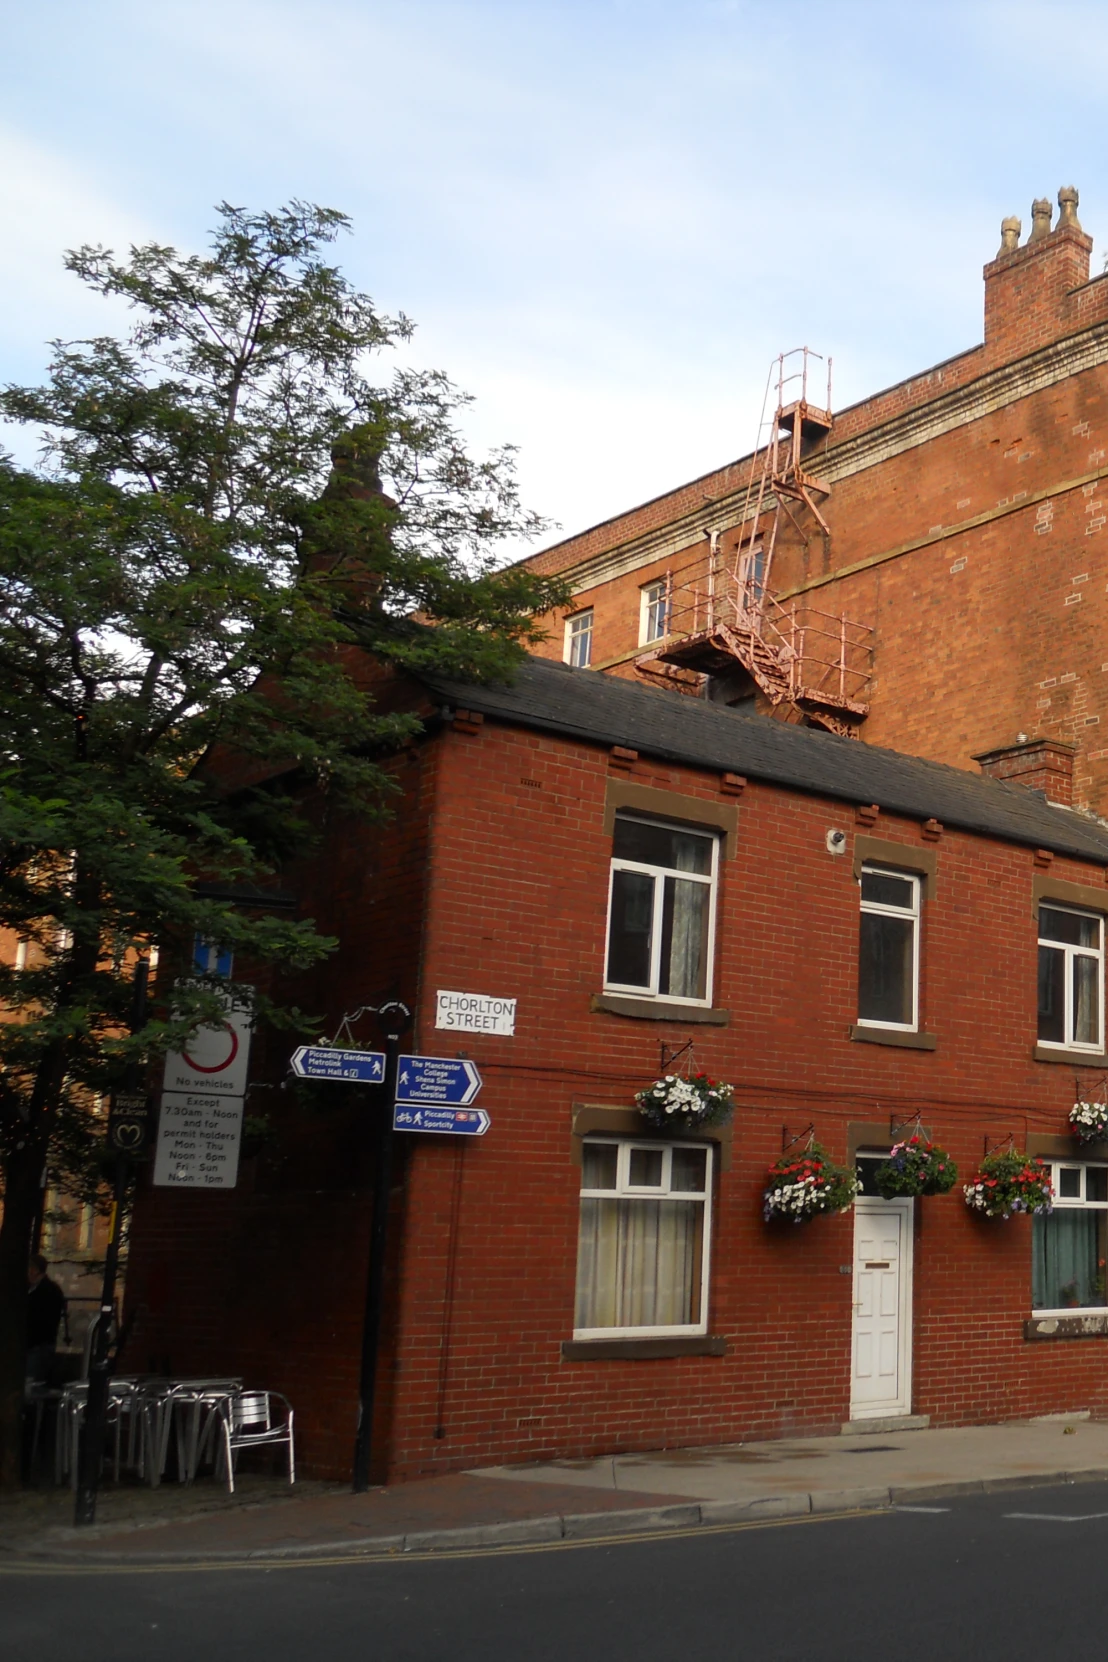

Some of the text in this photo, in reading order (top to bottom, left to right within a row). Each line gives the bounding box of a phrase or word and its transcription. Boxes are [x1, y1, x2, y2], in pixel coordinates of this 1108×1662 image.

[440, 995, 514, 1016] CHORLTON
[446, 1011, 499, 1029] STREET
[308, 1050, 372, 1063] Piccadilly Gardens
[308, 1058, 342, 1067] Metrolink
[411, 1060, 461, 1071] The Manchester
[307, 1066, 326, 1074] Town
[327, 1068, 342, 1076] Hall
[423, 1069, 448, 1078] College
[176, 1077, 234, 1089] No vehicles
[415, 1075, 456, 1085] Shena Simon
[420, 1083, 446, 1092] Campus
[409, 1089, 447, 1099] Universities
[186, 1097, 220, 1108] Except
[165, 1106, 203, 1117] 7.30am
[213, 1109, 238, 1119] Noon
[424, 1110, 455, 1120] Piccadilly
[183, 1120, 218, 1129] and for
[423, 1120, 454, 1130] Sportcity
[163, 1130, 236, 1141] permit holders
[174, 1140, 196, 1149] Mon
[206, 1141, 224, 1151] Thu
[169, 1151, 195, 1160] Noon
[205, 1152, 226, 1162] 6pm
[175, 1162, 189, 1171] Fri
[199, 1163, 218, 1172] Sun
[205, 1174, 224, 1184] 1pm
